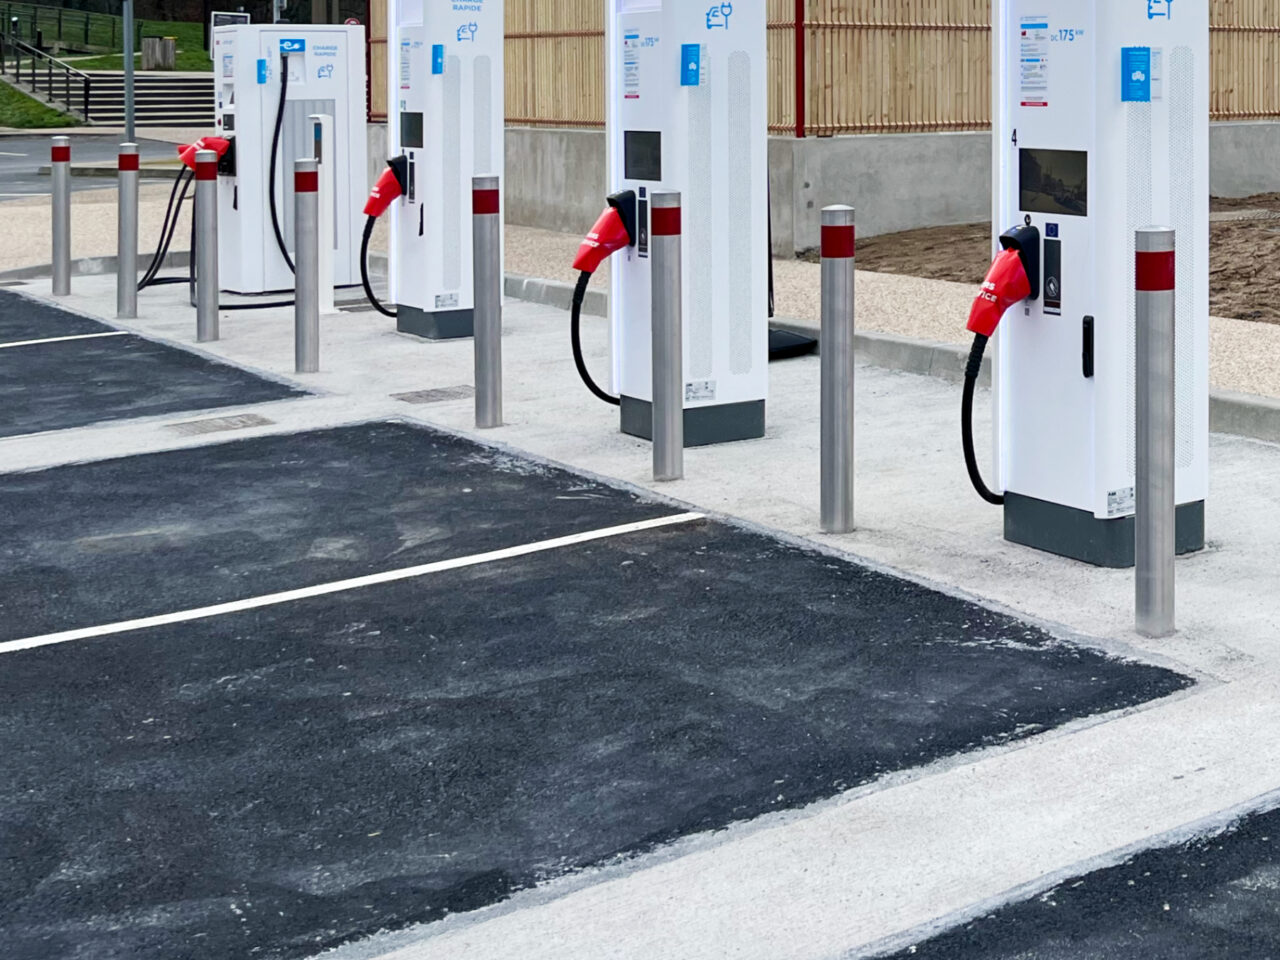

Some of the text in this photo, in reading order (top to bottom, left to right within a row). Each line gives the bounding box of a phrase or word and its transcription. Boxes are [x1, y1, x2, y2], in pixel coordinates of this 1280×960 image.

[452, 4, 482, 12] RAPIDE
[1058, 29, 1075, 42] 175
[1011, 128, 1018, 147] 4
